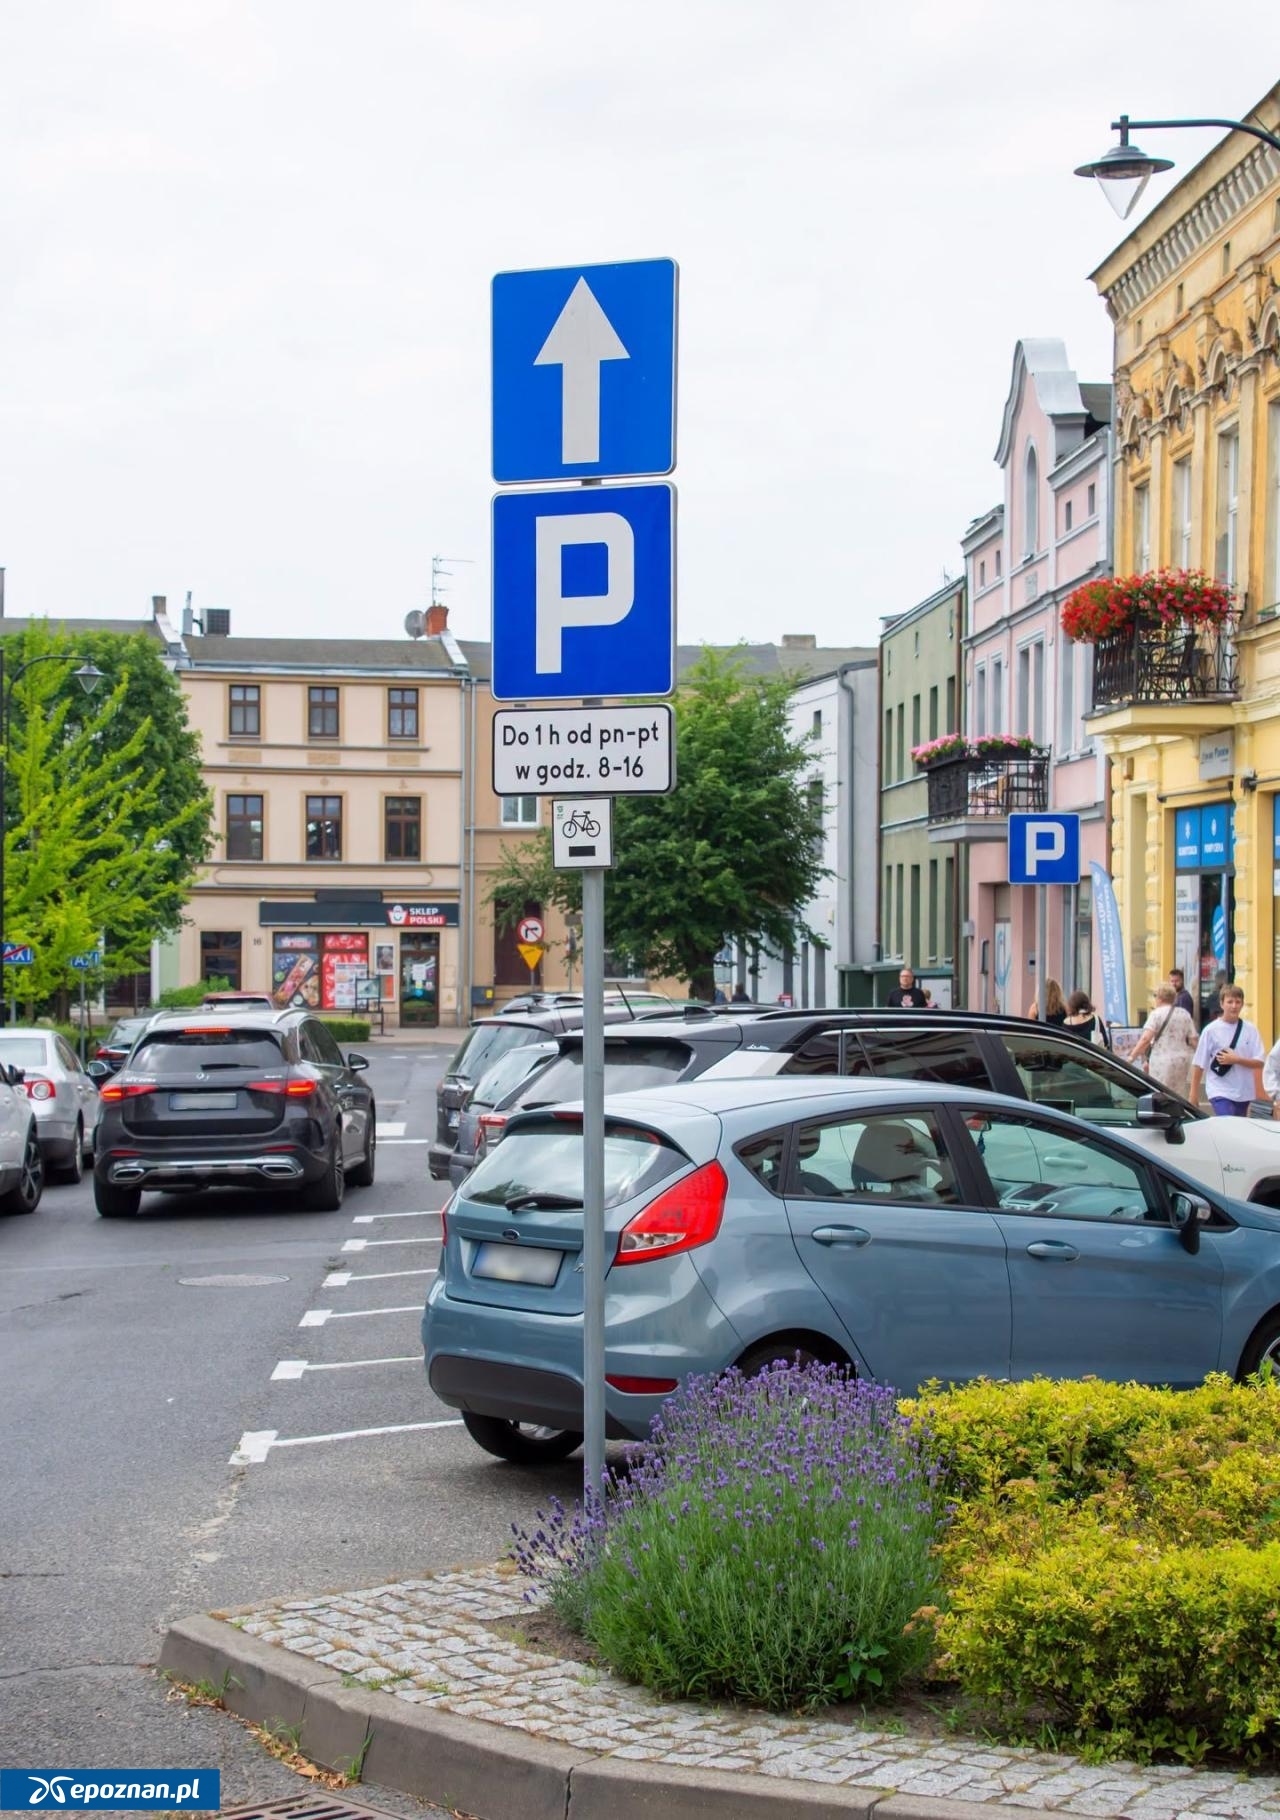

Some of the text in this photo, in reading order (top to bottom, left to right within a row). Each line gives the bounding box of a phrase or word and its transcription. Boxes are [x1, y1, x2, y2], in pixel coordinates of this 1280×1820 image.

[536, 512, 634, 674] P
[503, 721, 659, 750] Do 1 h od pn-pt
[516, 756, 644, 786] w godz. 8-16
[1025, 822, 1065, 876] P
[409, 907, 439, 916] SKLEP
[410, 916, 445, 925] POLSKI
[3, 945, 31, 961] AXI
